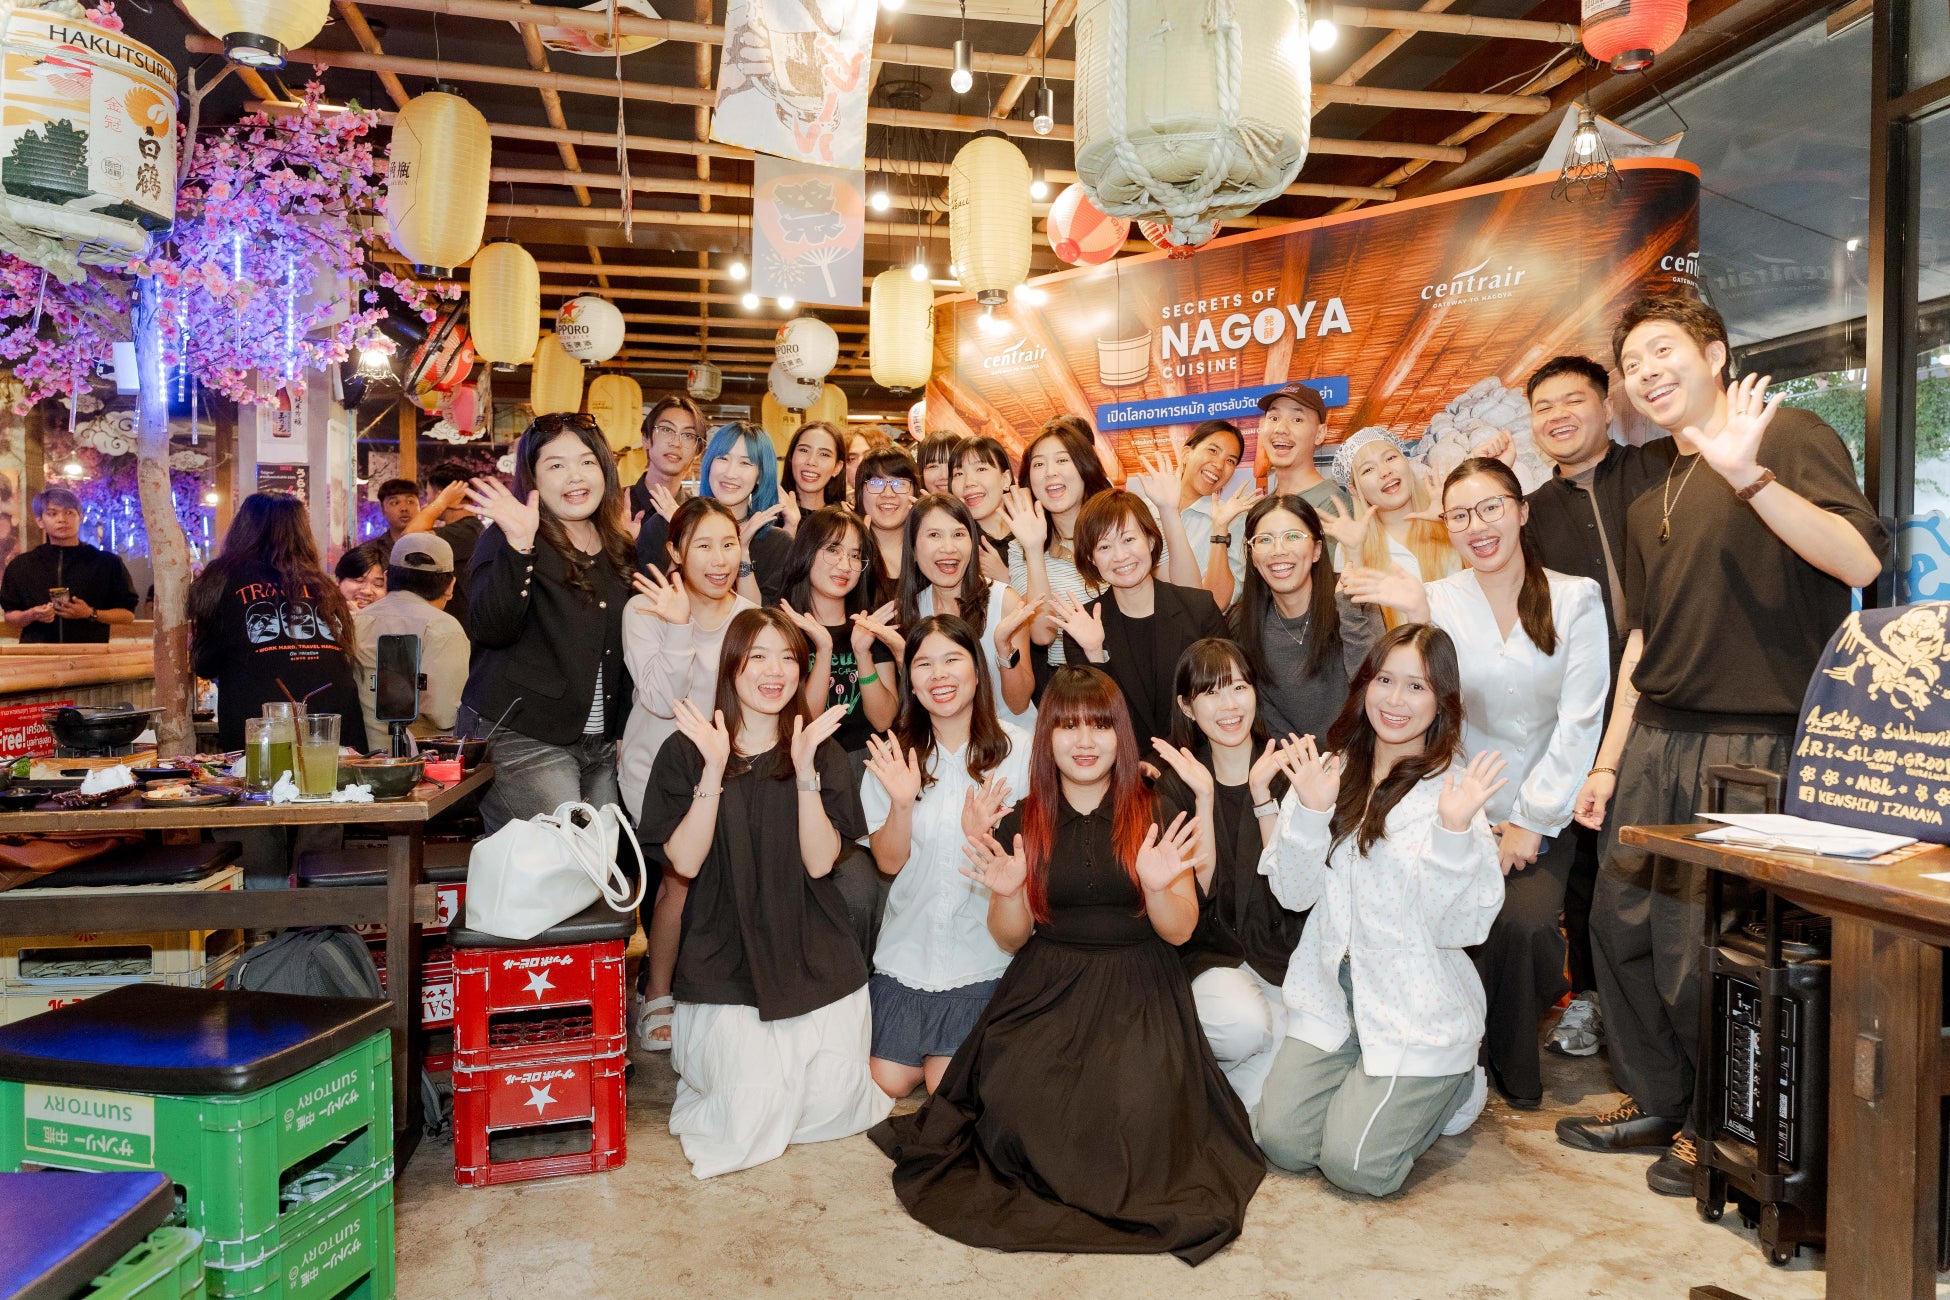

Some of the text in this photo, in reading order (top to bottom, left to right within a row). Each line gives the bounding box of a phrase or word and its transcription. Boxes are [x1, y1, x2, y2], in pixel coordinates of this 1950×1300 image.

[49, 24, 172, 84] HAKUTSURU
[134, 125, 161, 200] 白鶴
[1420, 262, 1526, 300] centrair
[1481, 291, 1513, 302] NAGOYA
[1162, 287, 1276, 319] SECRETS OF
[1161, 296, 1353, 360] NAGOYA
[983, 343, 1047, 369] centrair
[1162, 356, 1238, 379] CUISINE
[1818, 790, 1943, 826] KENSHIN IZAKAYA
[502, 954, 574, 971] サッポロビール
[504, 1068, 576, 1086] サッポロビール
[42, 1126, 135, 1157] サントリー 中瓶
